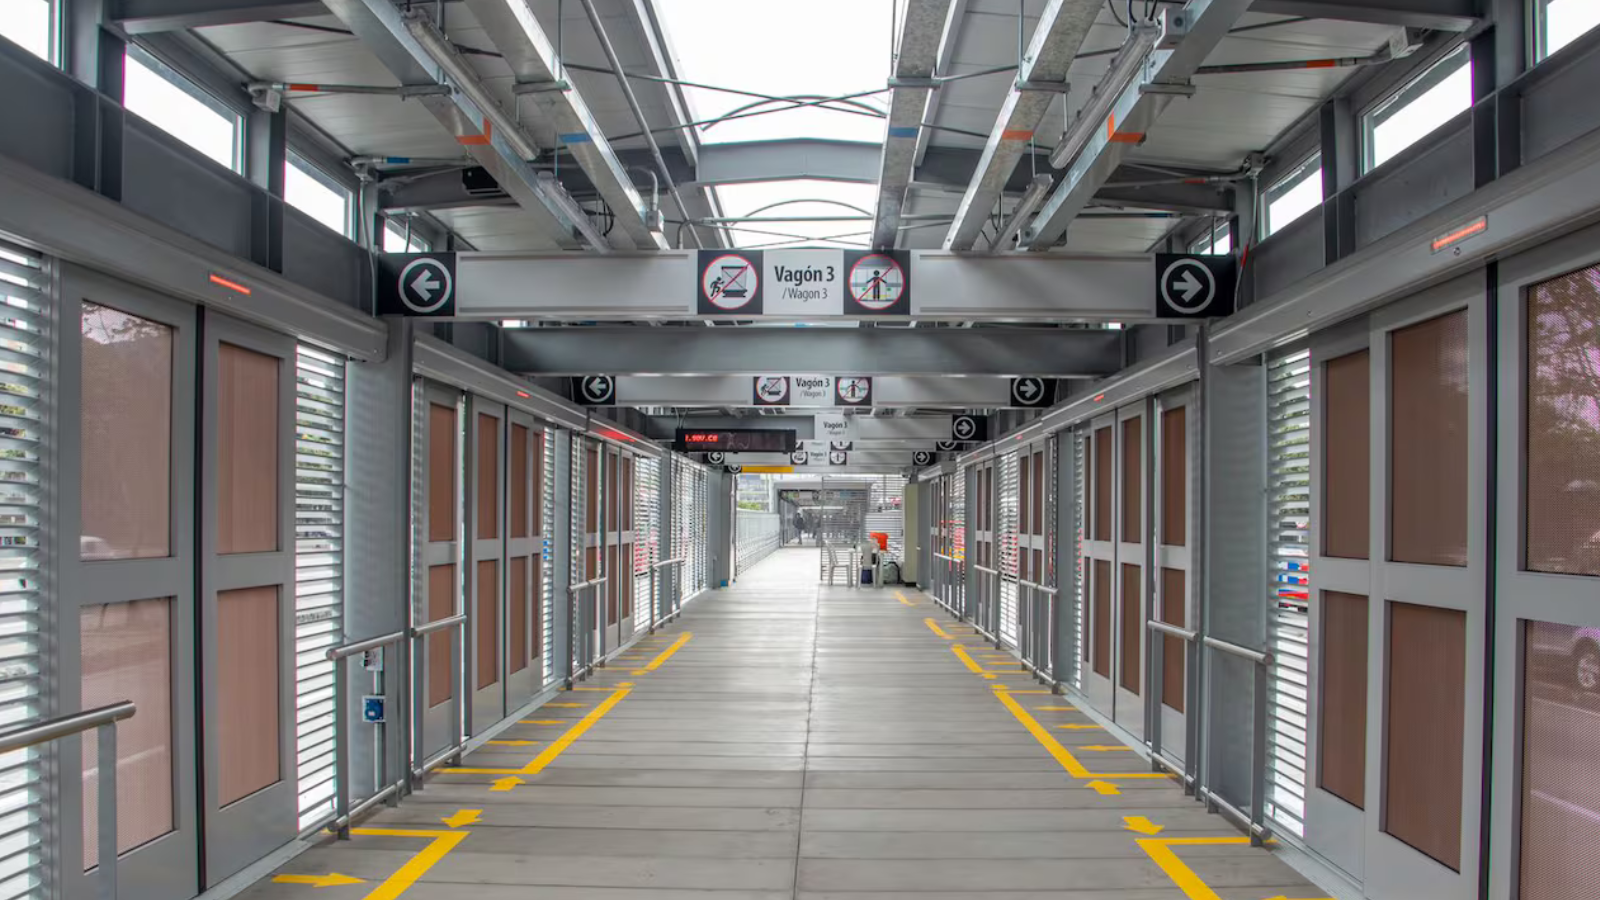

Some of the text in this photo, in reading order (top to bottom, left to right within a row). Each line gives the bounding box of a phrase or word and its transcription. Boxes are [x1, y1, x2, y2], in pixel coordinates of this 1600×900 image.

[774, 265, 835, 286] Vagón 3
[822, 288, 828, 299] 3
[796, 377, 831, 390] Vagón 3
